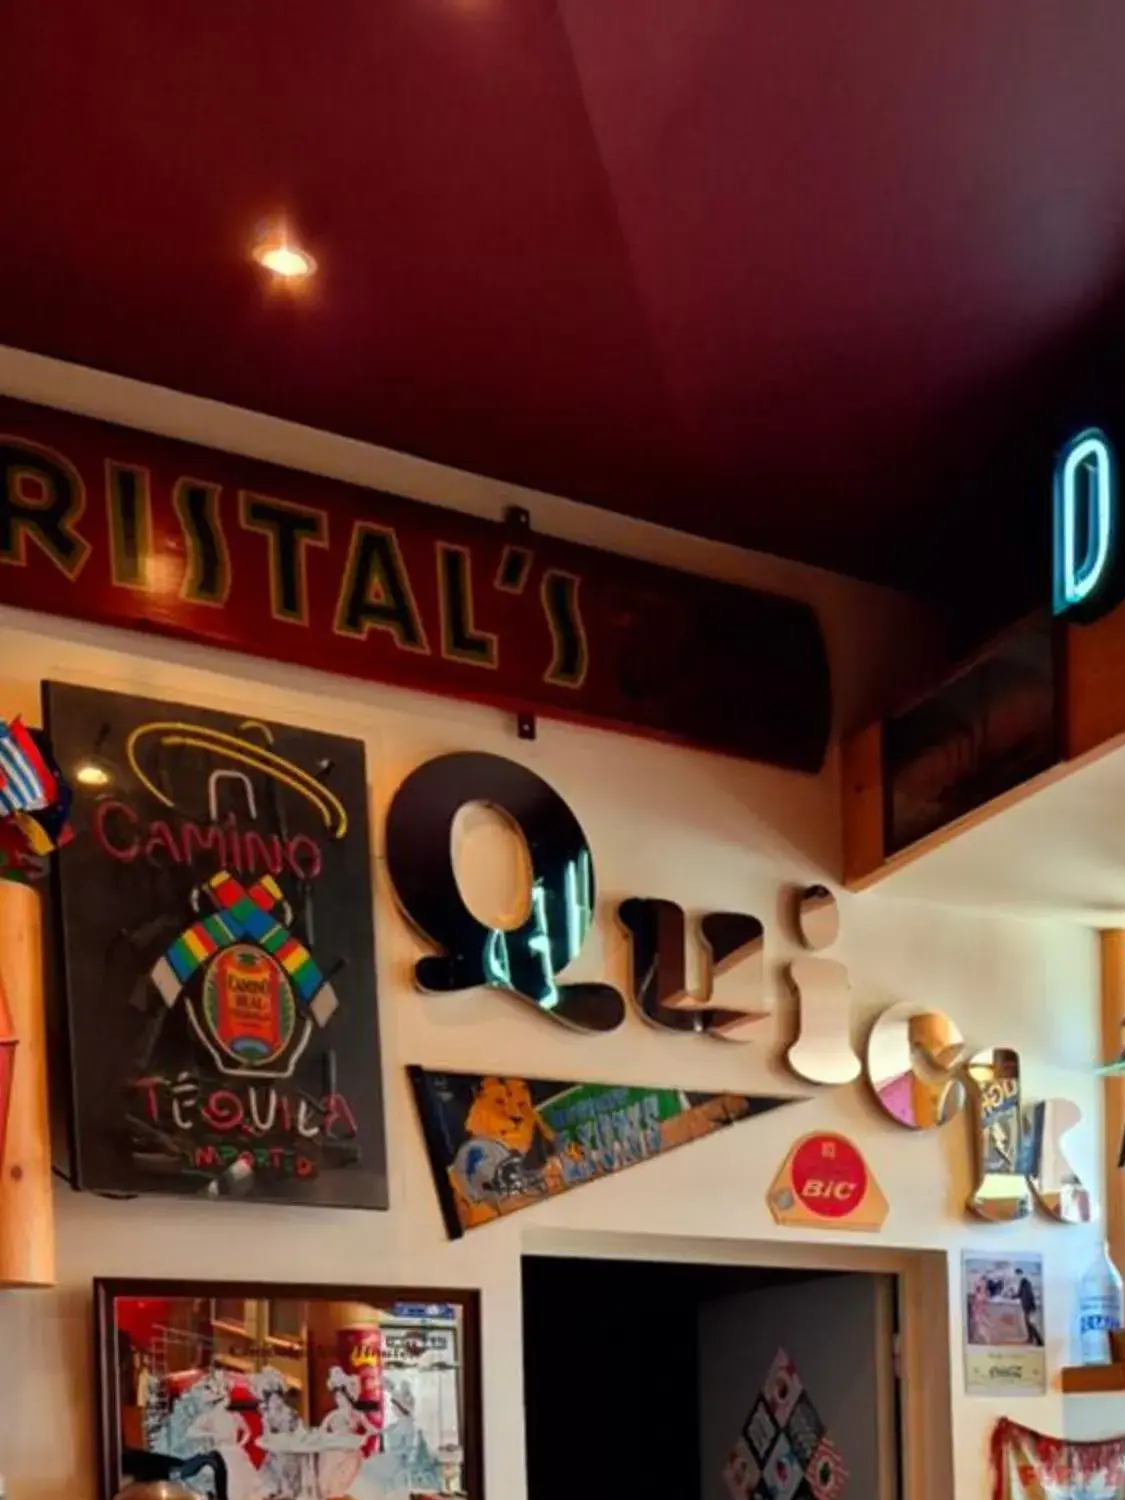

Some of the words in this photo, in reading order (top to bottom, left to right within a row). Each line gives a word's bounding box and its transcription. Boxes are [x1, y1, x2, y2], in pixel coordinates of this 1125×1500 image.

[0, 436, 588, 688] RISTAL'S
[93, 799, 322, 880] CAMINO
[386, 751, 1092, 1226] Quick
